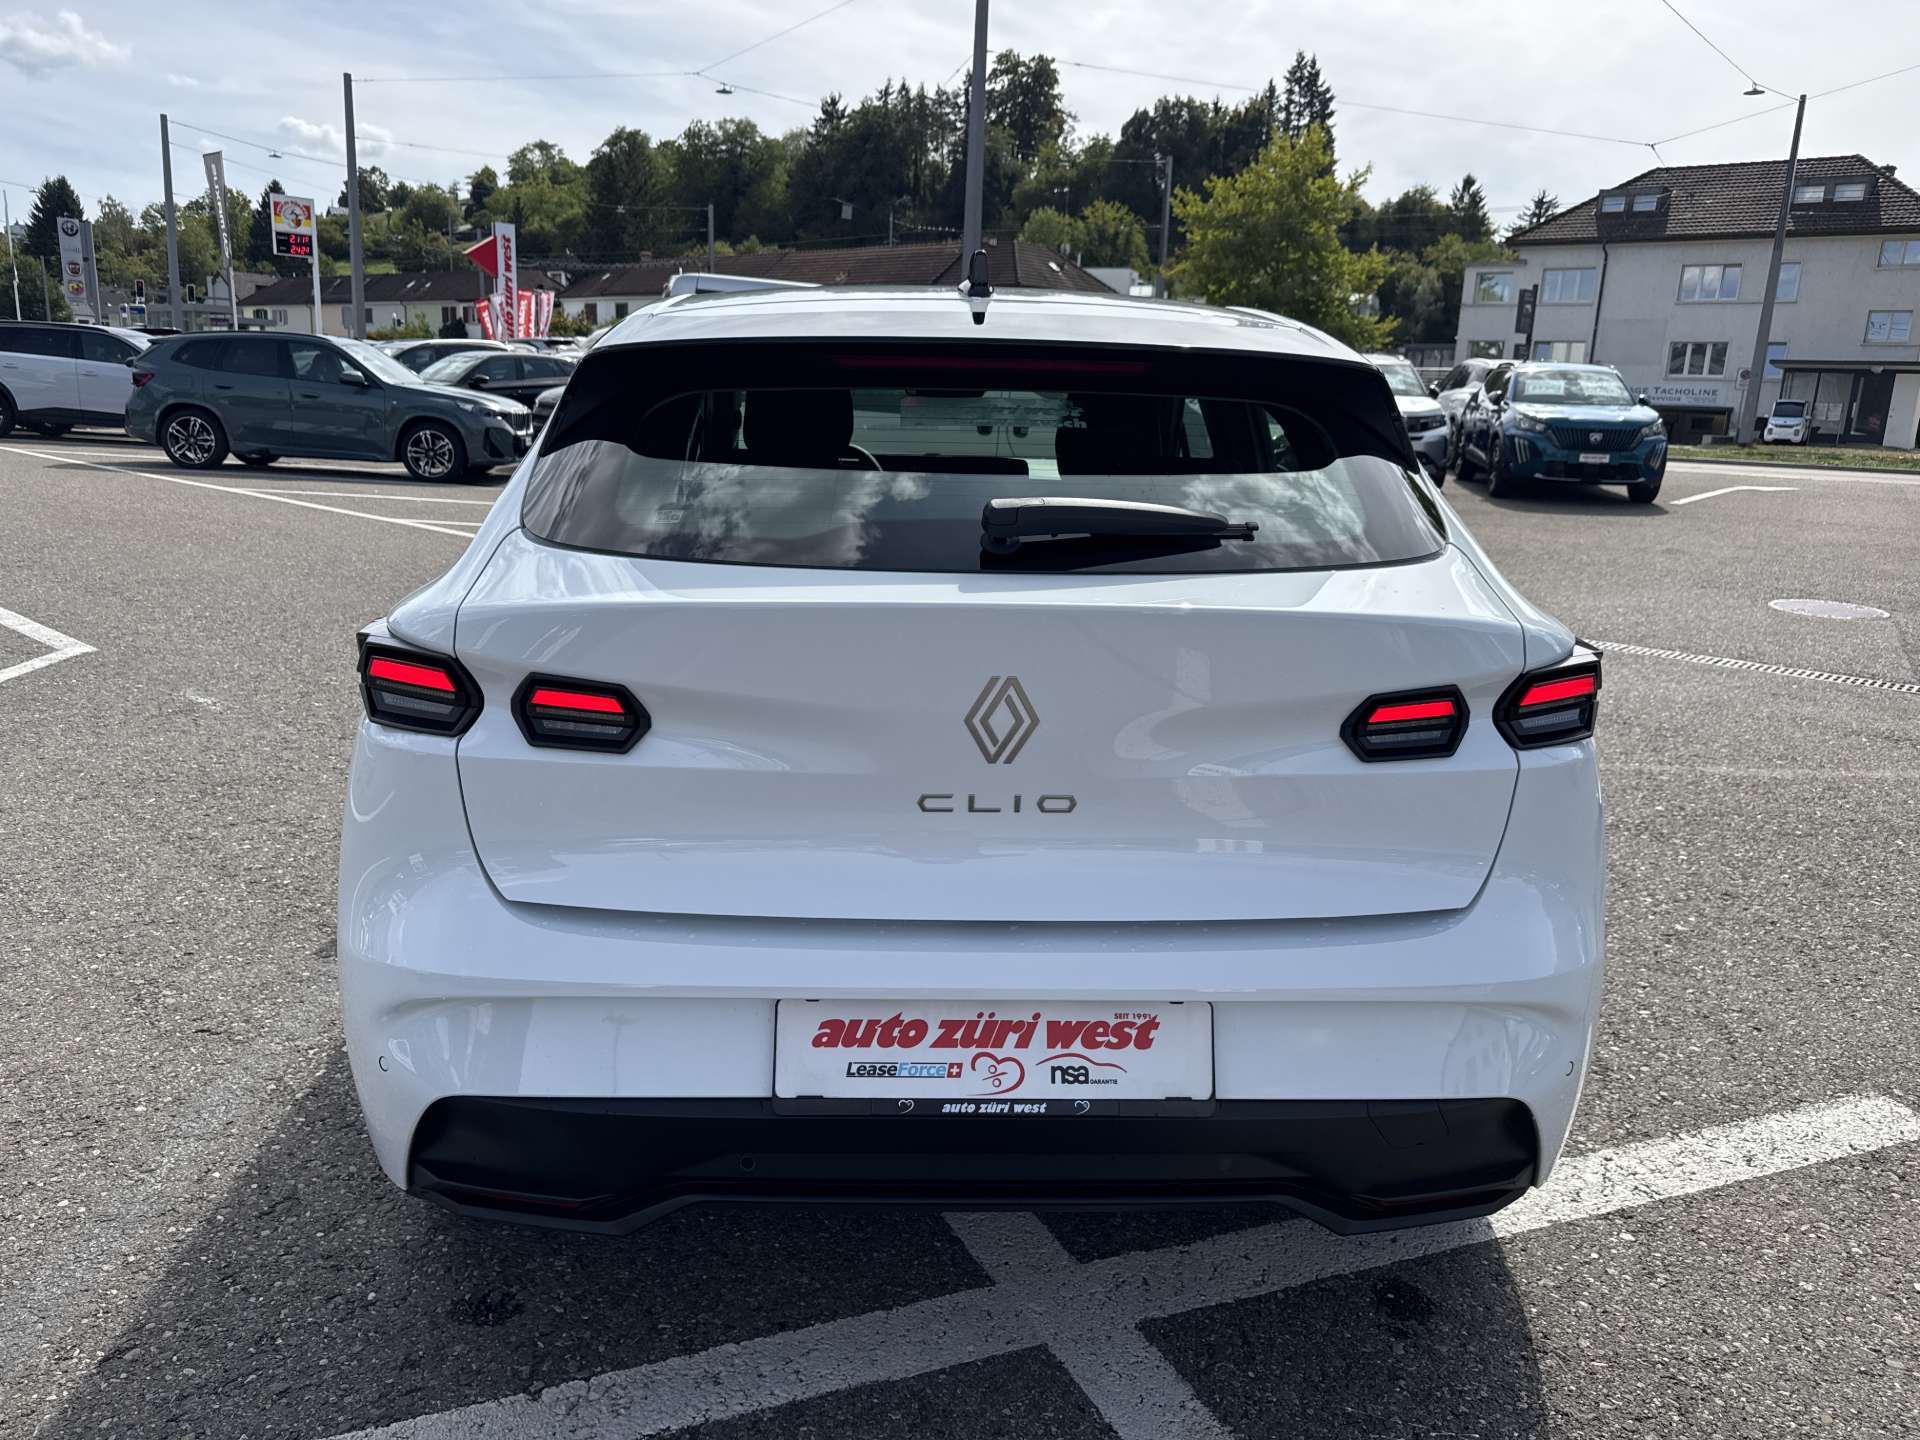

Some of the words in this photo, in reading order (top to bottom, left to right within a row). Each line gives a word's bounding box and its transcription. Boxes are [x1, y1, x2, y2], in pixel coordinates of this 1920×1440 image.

[502, 234, 512, 272] west
[916, 794, 1078, 813] CLIO
[811, 1012, 929, 1049] auto
[929, 1011, 1041, 1049] züri
[1046, 1014, 1161, 1050] west
[846, 1062, 947, 1077] LeaseForce
[1050, 1065, 1090, 1085] nsa
[942, 1102, 976, 1113] auto
[979, 1101, 1010, 1113] züri
[1013, 1102, 1048, 1113] west
